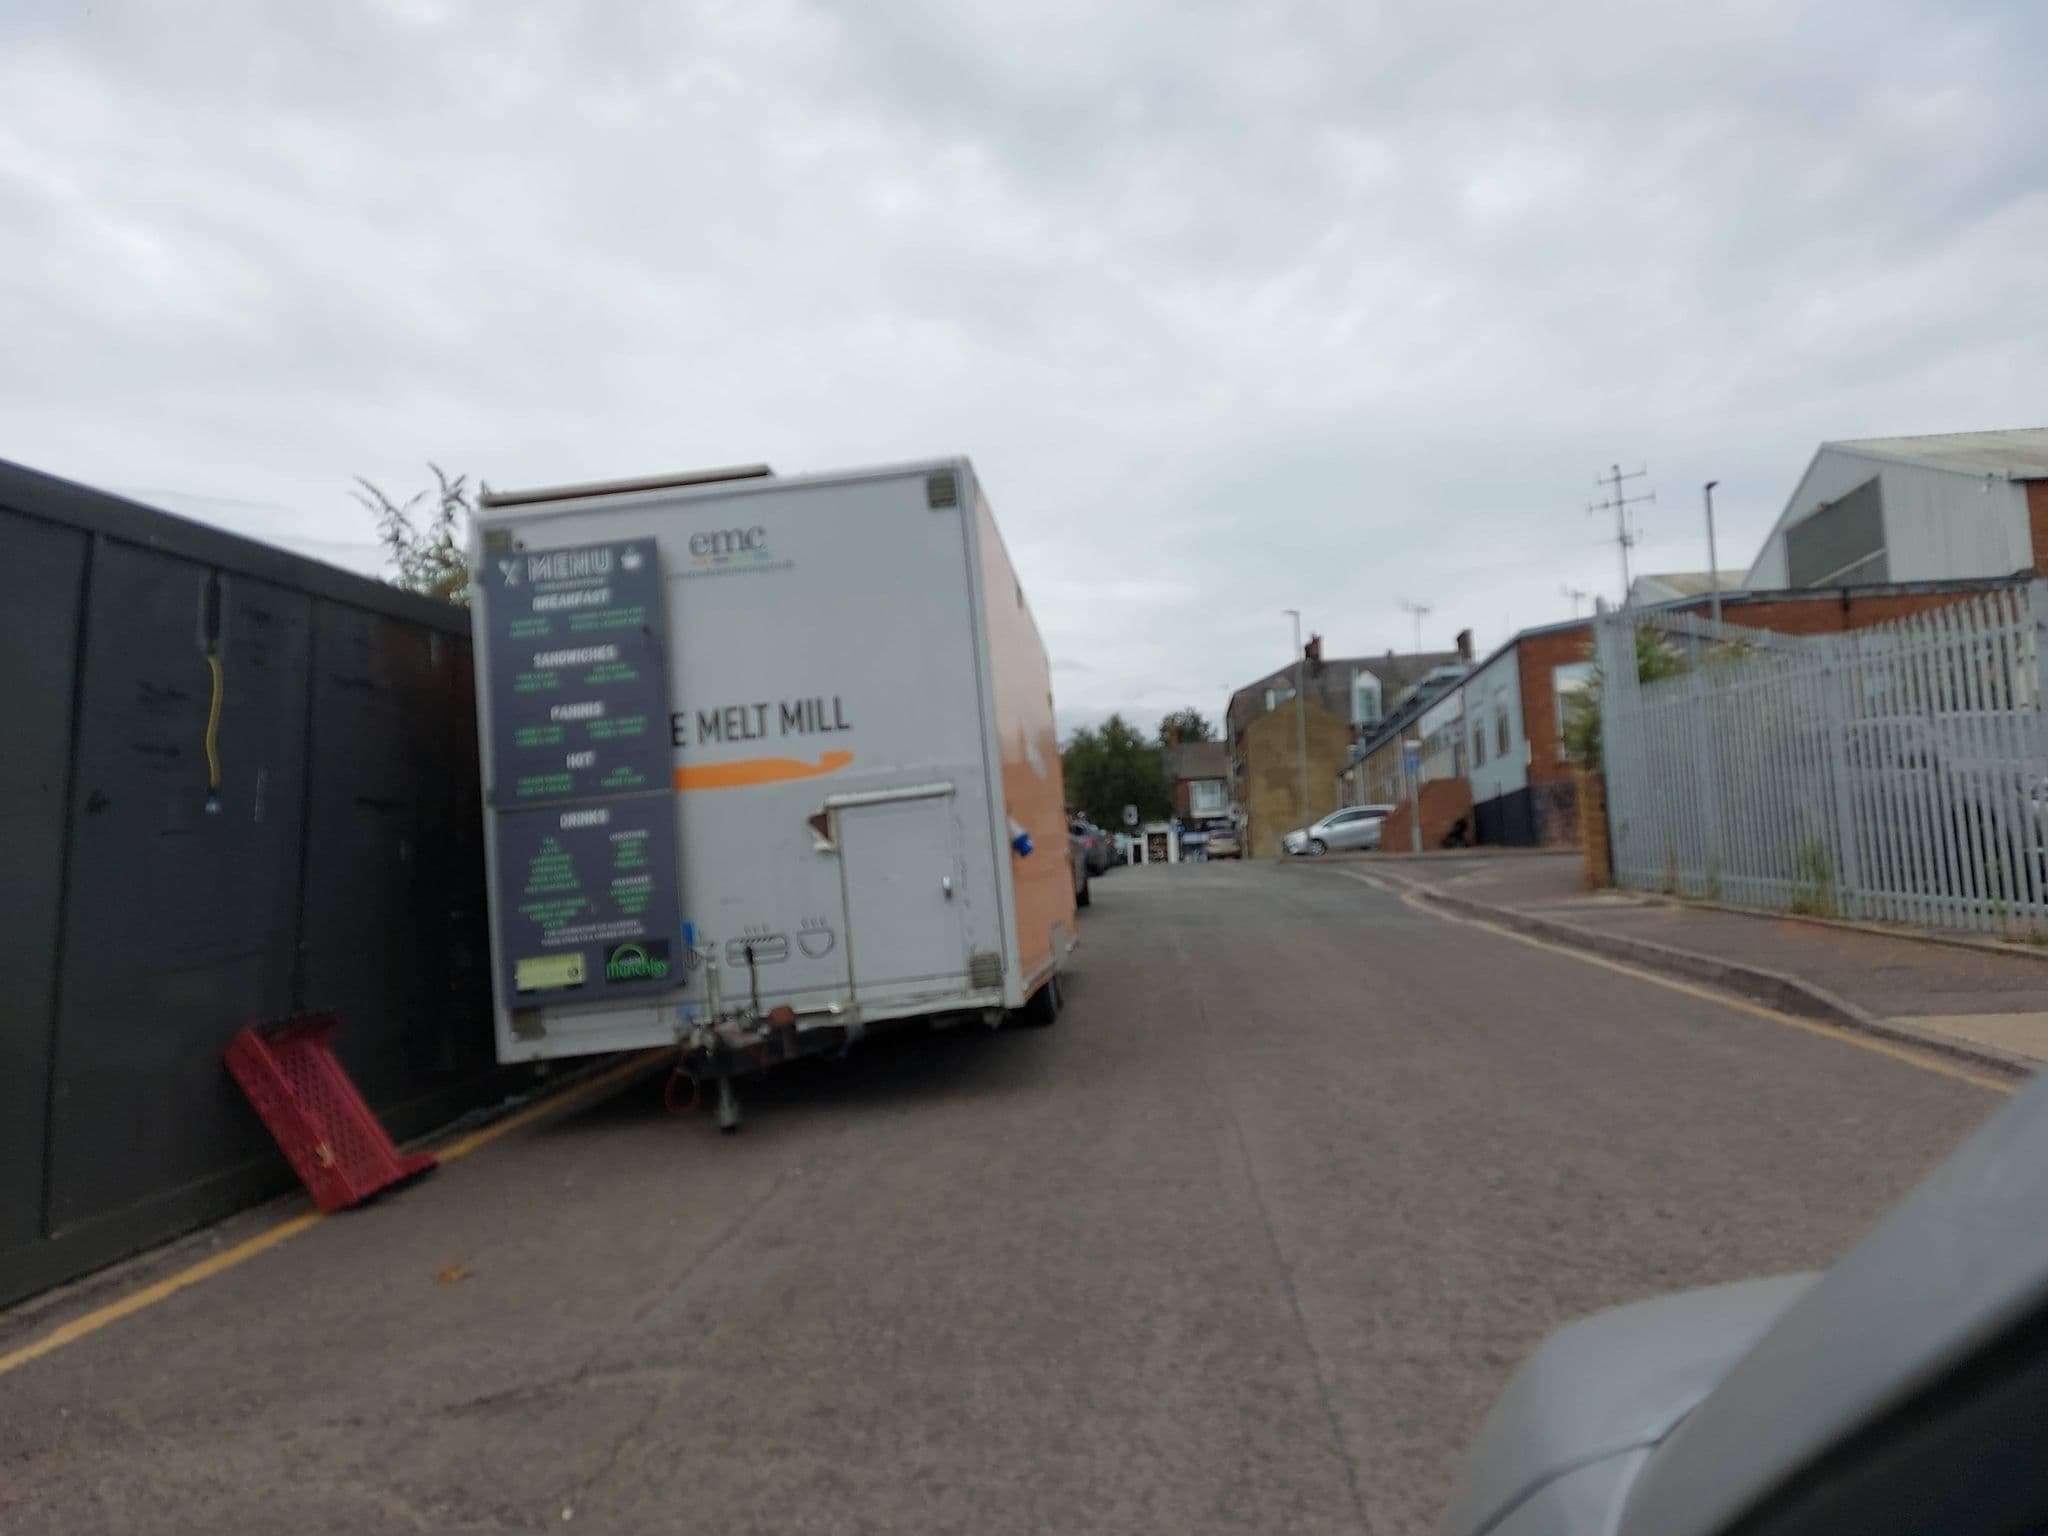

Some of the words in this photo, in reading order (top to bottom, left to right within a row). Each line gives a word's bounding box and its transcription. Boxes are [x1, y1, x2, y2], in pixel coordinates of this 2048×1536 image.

[688, 527, 767, 555] emc
[527, 548, 612, 582] MENU
[532, 588, 613, 611] BREAKFAST
[533, 645, 618, 668] SANDWICHES
[550, 701, 606, 721] PANINIS
[697, 703, 768, 745] MELT
[779, 696, 853, 737] MILL
[566, 751, 596, 769] HOT
[560, 809, 609, 829] DRINKS
